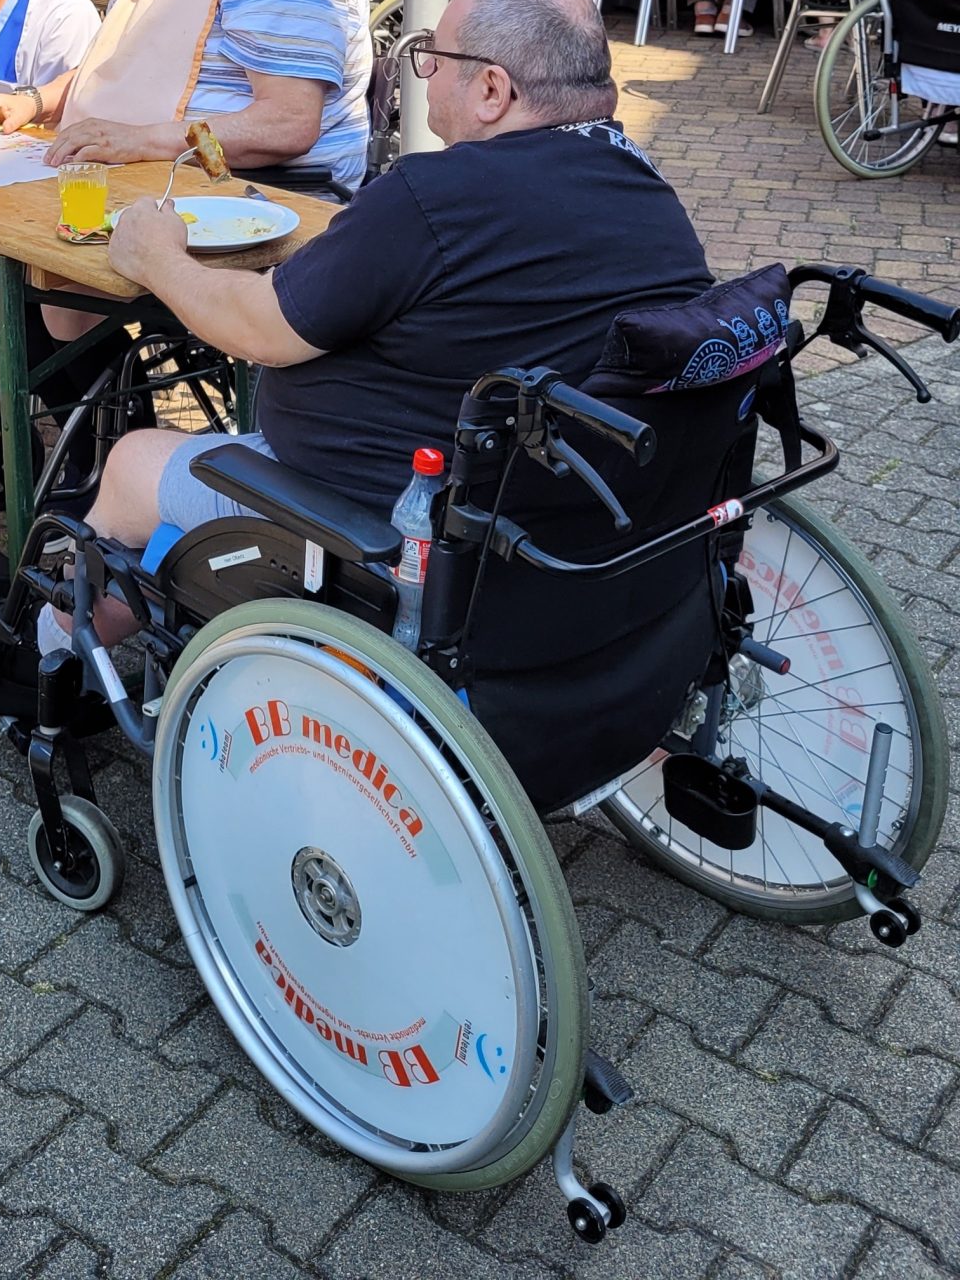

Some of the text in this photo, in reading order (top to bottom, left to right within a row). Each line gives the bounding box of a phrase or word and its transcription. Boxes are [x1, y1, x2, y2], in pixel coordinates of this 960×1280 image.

[936, 21, 960, 34] MEY
[244, 699, 424, 838] BB medica
[249, 742, 417, 860] medizinische Vertriebs- und Ingenieurgesellschaft mbH
[254, 938, 441, 1088] BB medica
[337, 1019, 352, 1032] und
